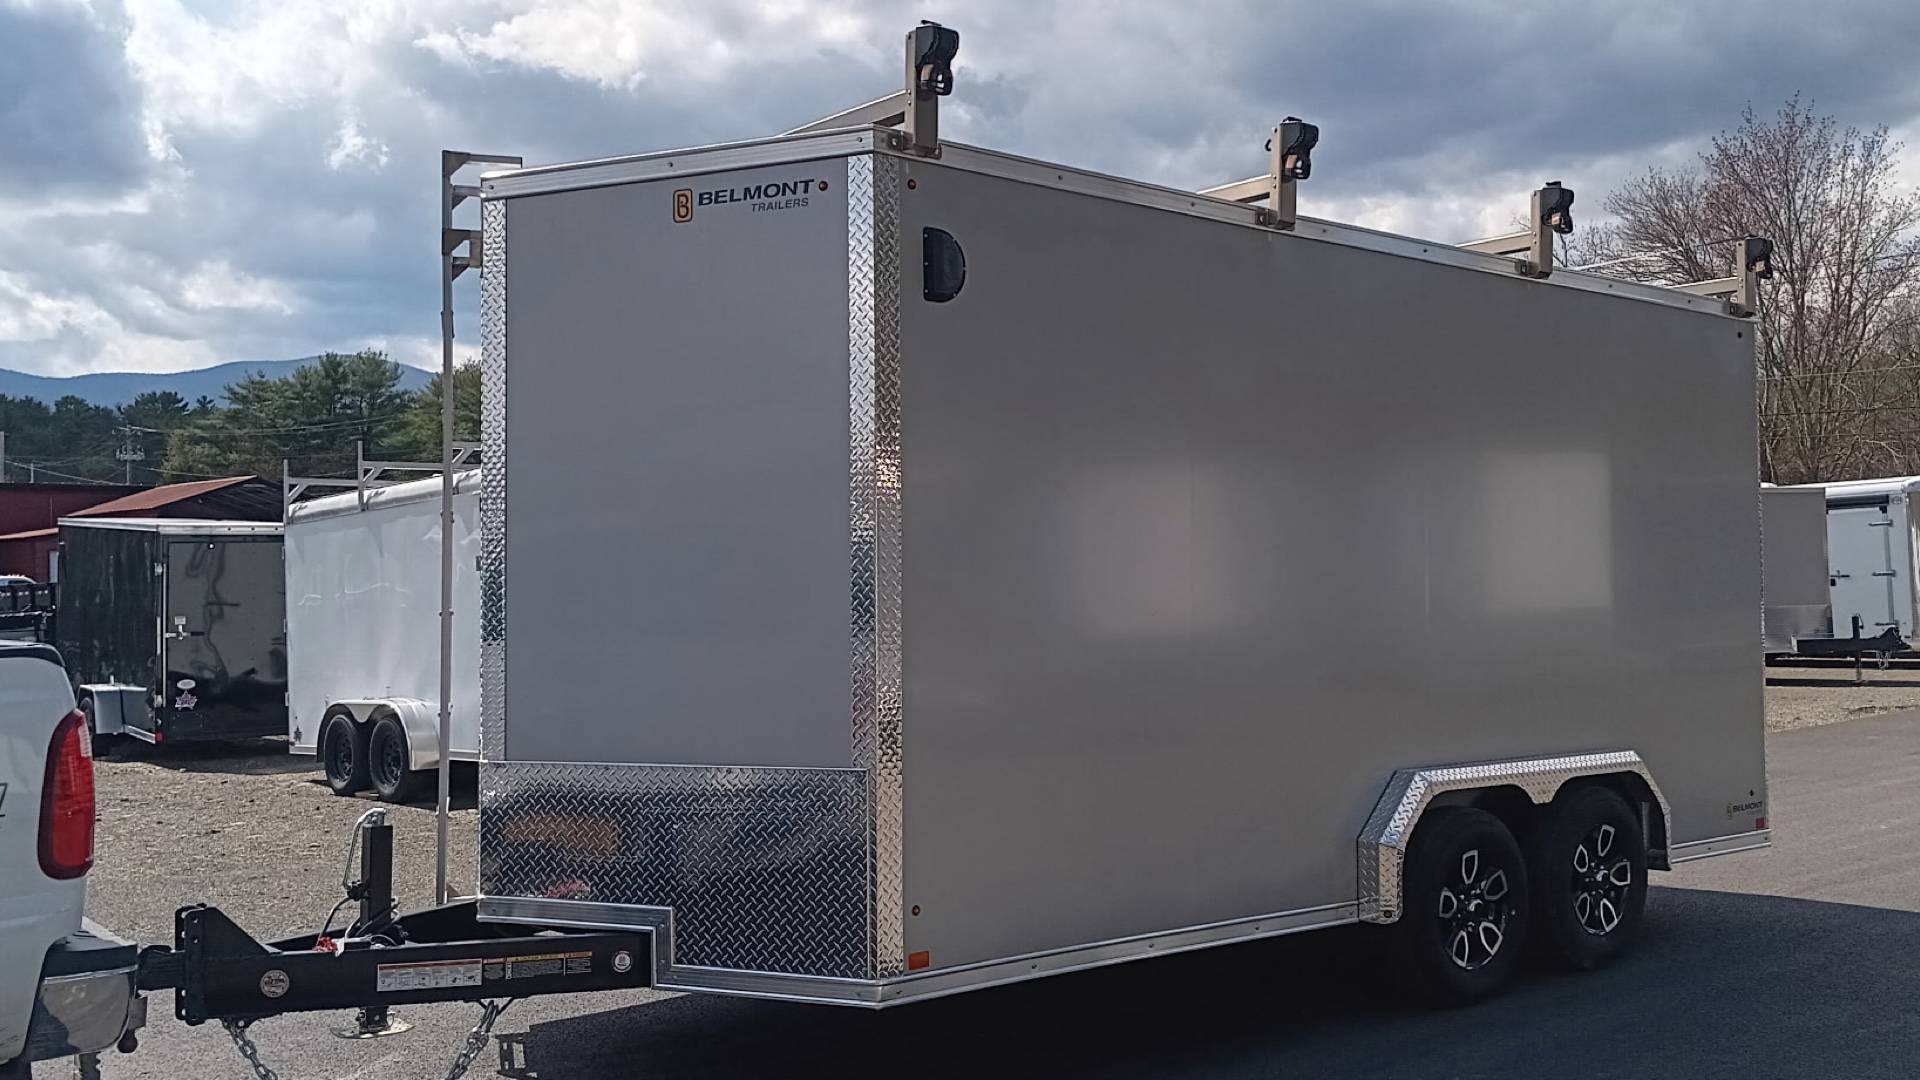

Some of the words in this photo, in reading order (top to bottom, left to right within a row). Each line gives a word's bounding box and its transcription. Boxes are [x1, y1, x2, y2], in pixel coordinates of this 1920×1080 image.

[698, 179, 815, 206] BELMONT
[751, 197, 809, 212] TRAILERS
[1732, 801, 1763, 812] BELMONT
